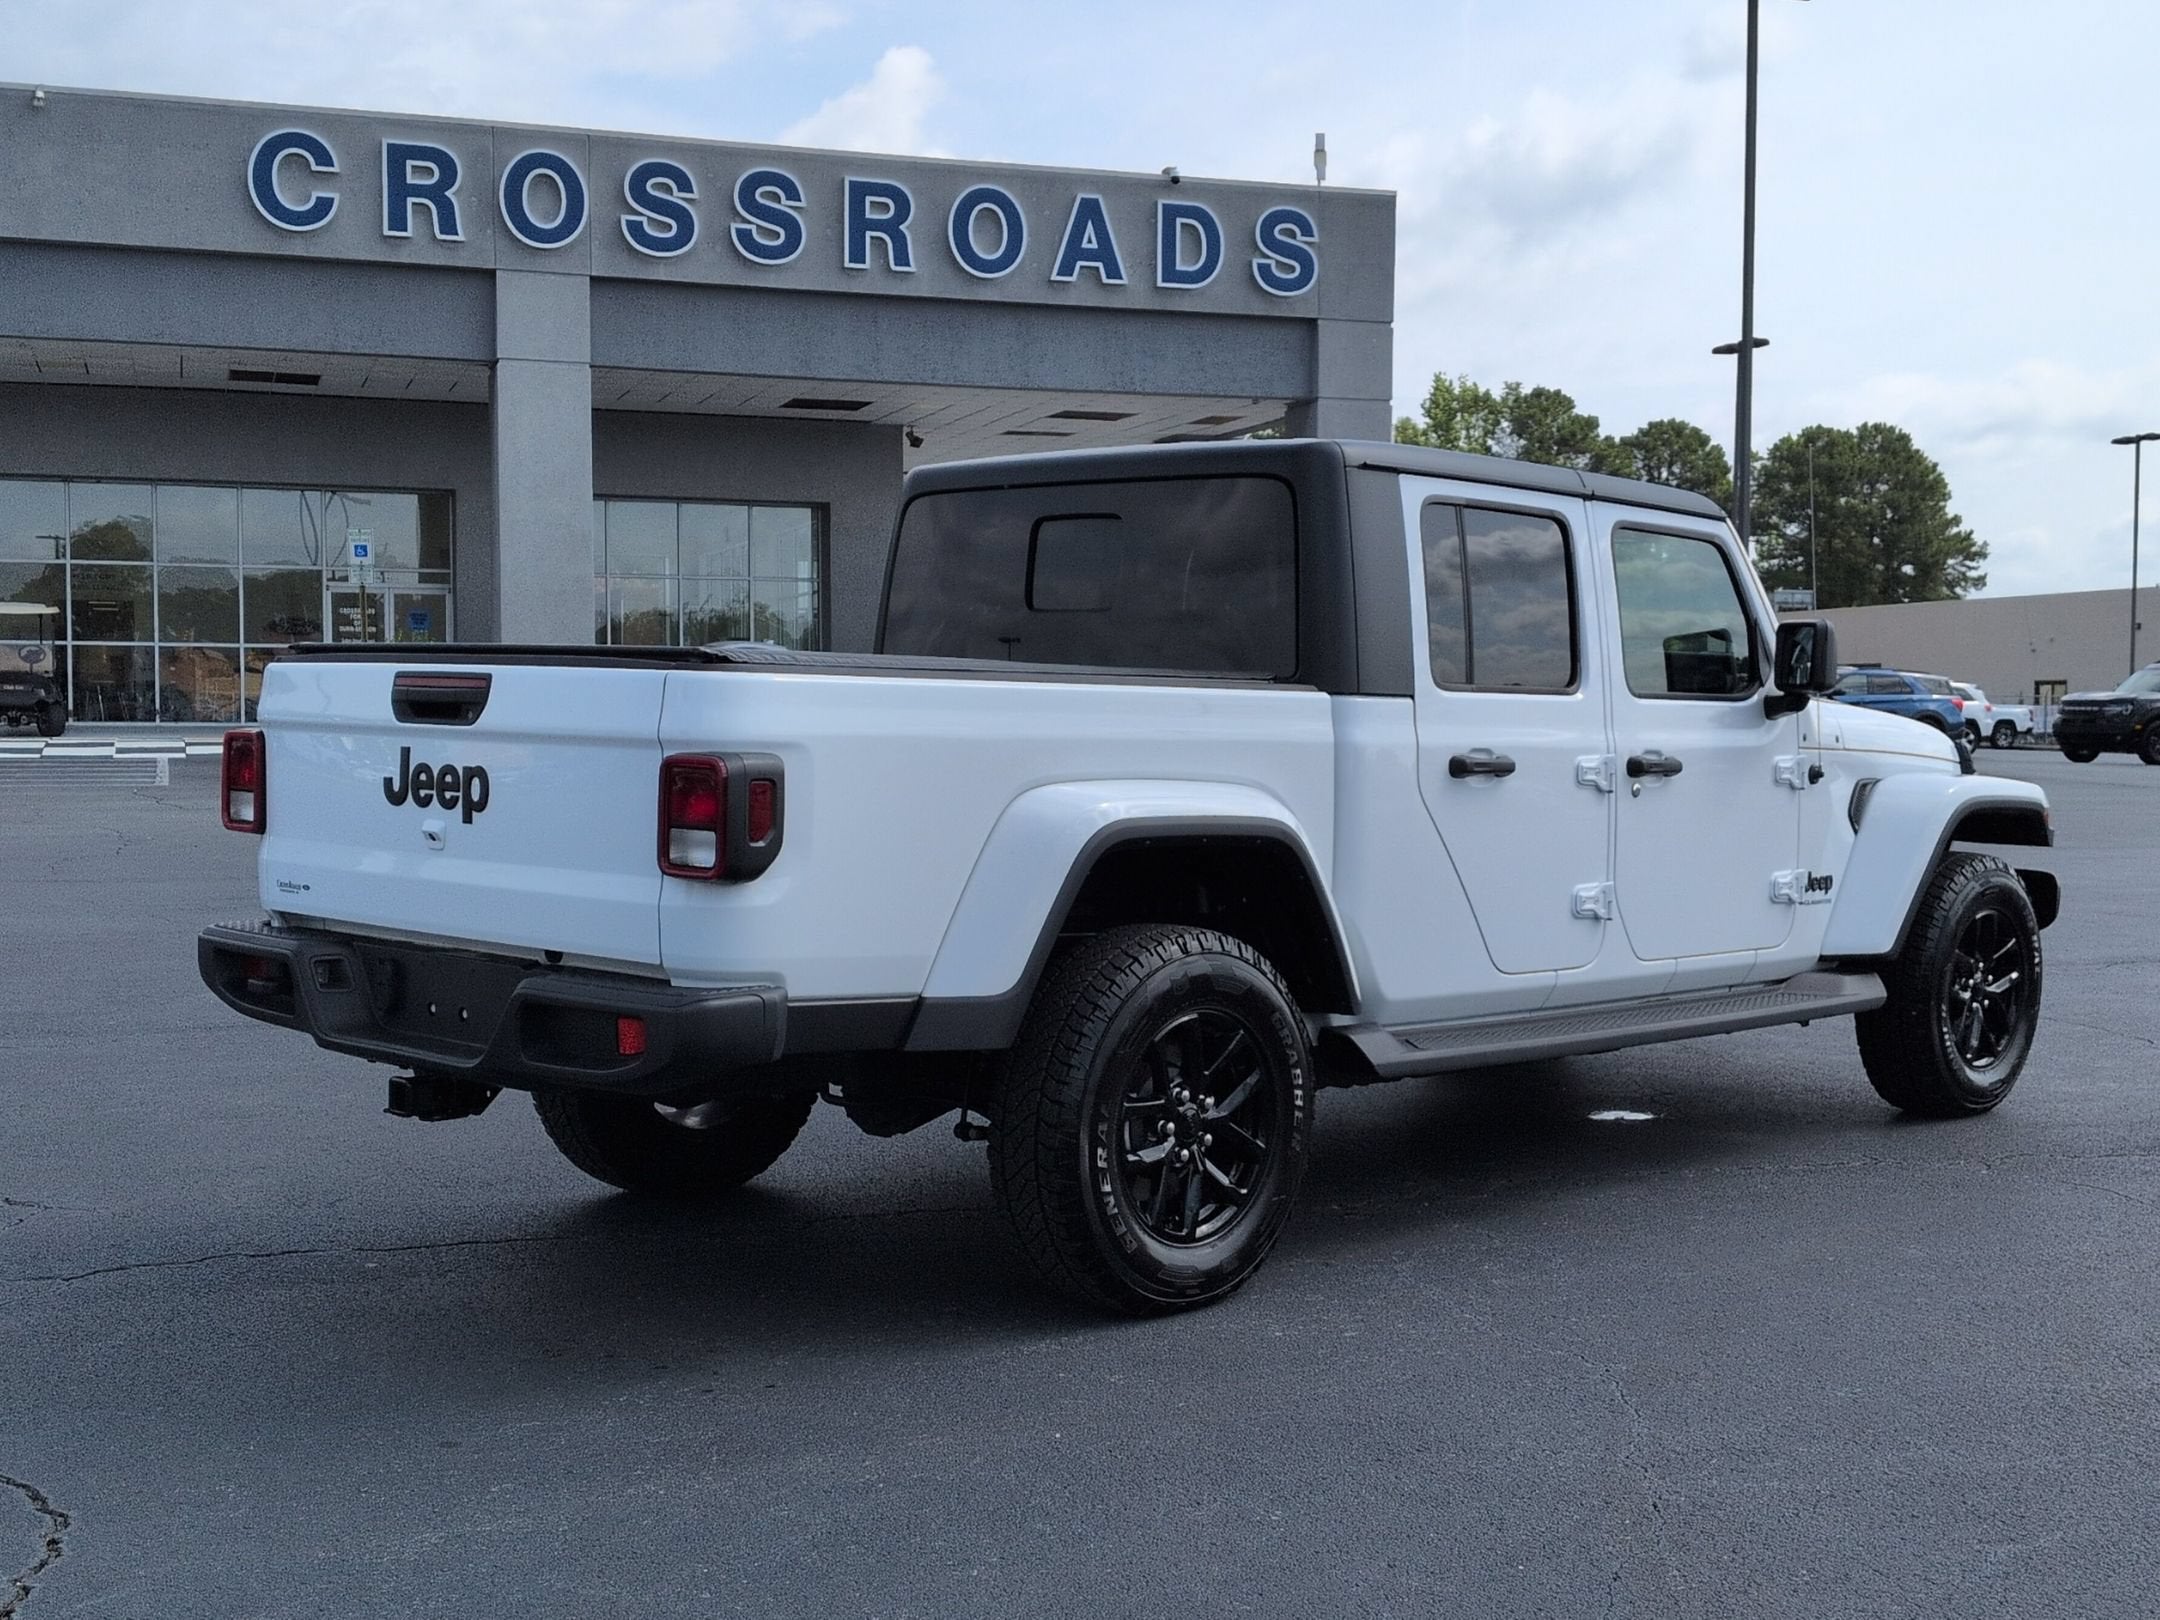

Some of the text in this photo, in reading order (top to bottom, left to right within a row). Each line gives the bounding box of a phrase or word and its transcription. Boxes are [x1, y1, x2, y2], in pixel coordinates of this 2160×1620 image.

[247, 128, 1319, 297] CROSSROADS
[383, 746, 490, 824] Jeep
[1804, 870, 1833, 895] Jeep
